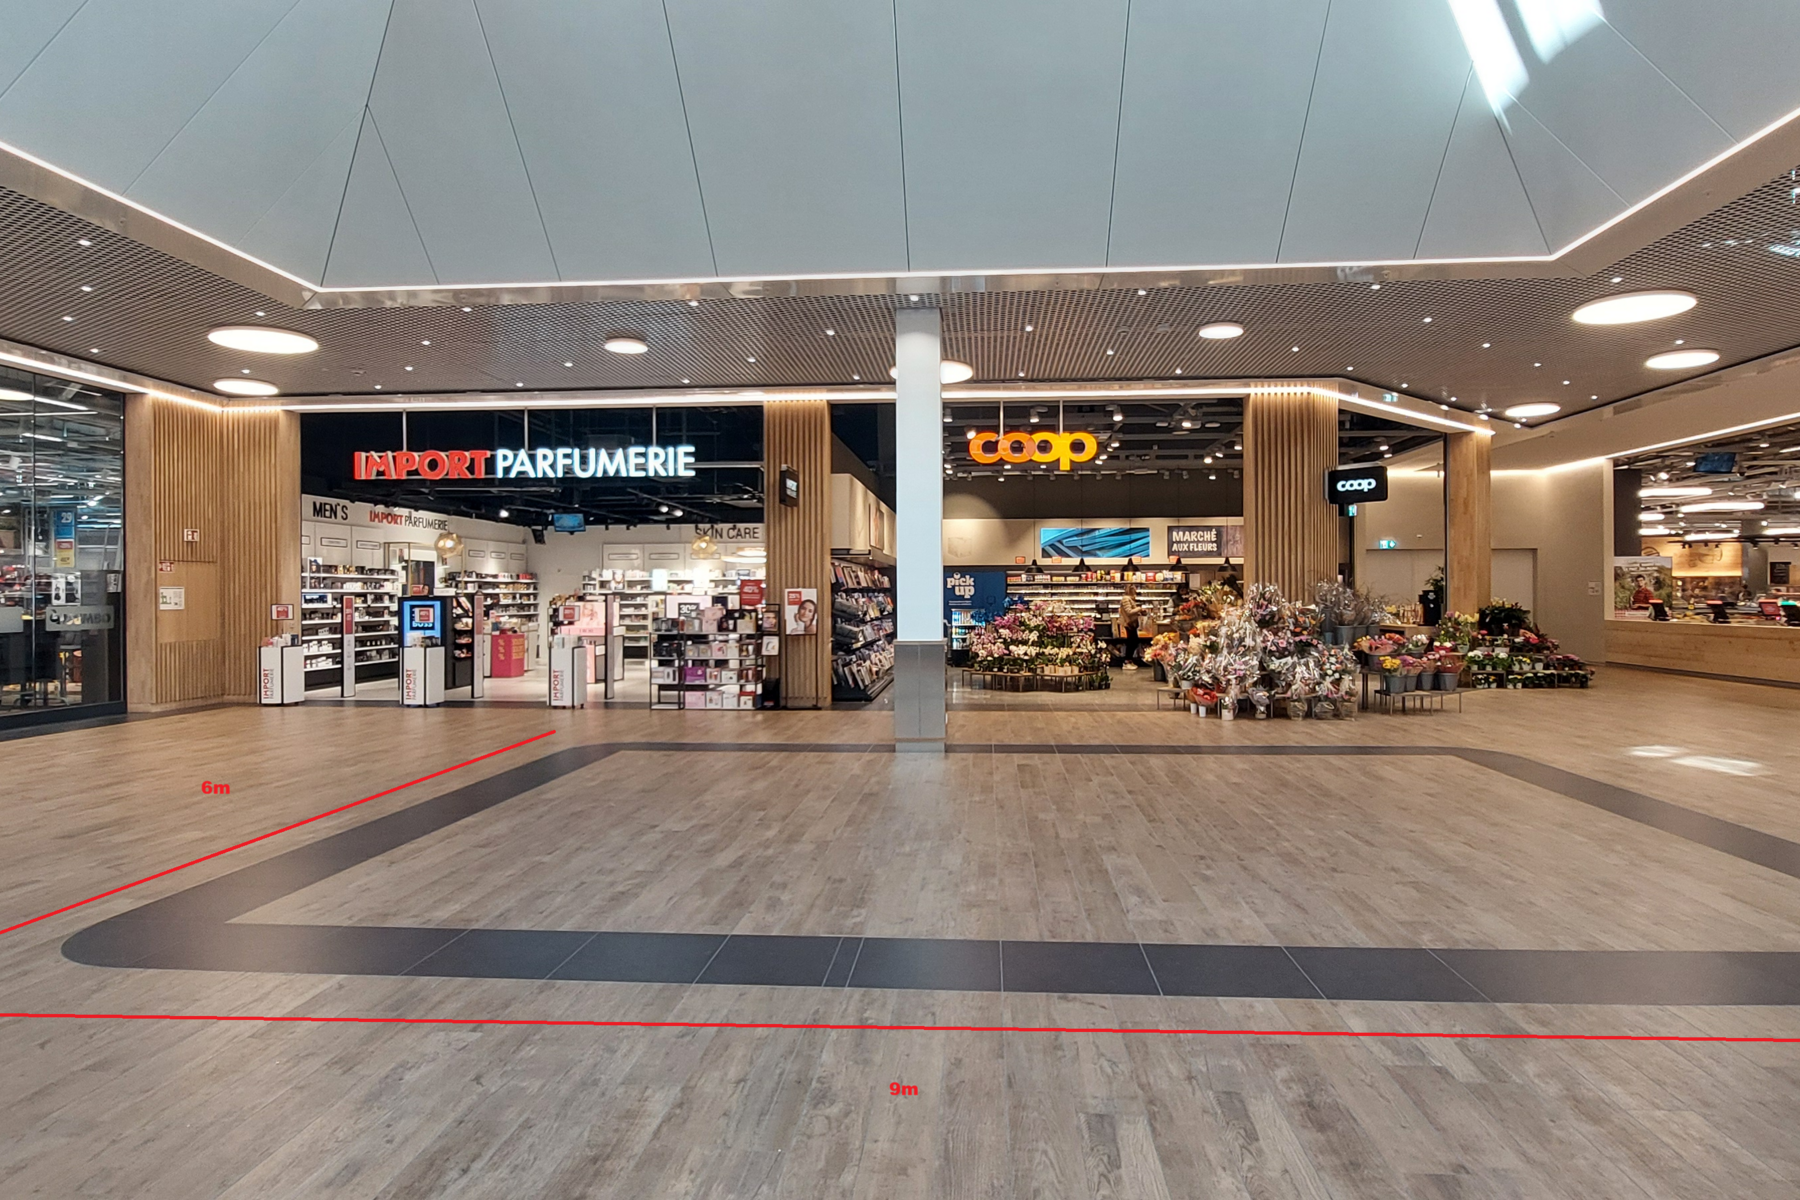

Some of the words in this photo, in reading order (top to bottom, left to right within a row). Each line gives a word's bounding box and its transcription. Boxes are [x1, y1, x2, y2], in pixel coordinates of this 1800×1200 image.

[969, 431, 1097, 471] coop
[353, 450, 490, 480] IMPORT
[495, 445, 697, 478] PARFUMERIE
[1336, 478, 1377, 492] coop
[61, 512, 73, 523] 29
[369, 510, 403, 526] IMPORT
[404, 514, 449, 531] PARFUMERIE
[726, 526, 760, 540] CARE
[1172, 528, 1218, 542] MARCHÉ
[1171, 543, 1189, 552] AUX
[1189, 543, 1218, 552] FLEURS
[946, 572, 975, 589] pick
[954, 586, 975, 599] up
[405, 668, 413, 700] IMPORT
